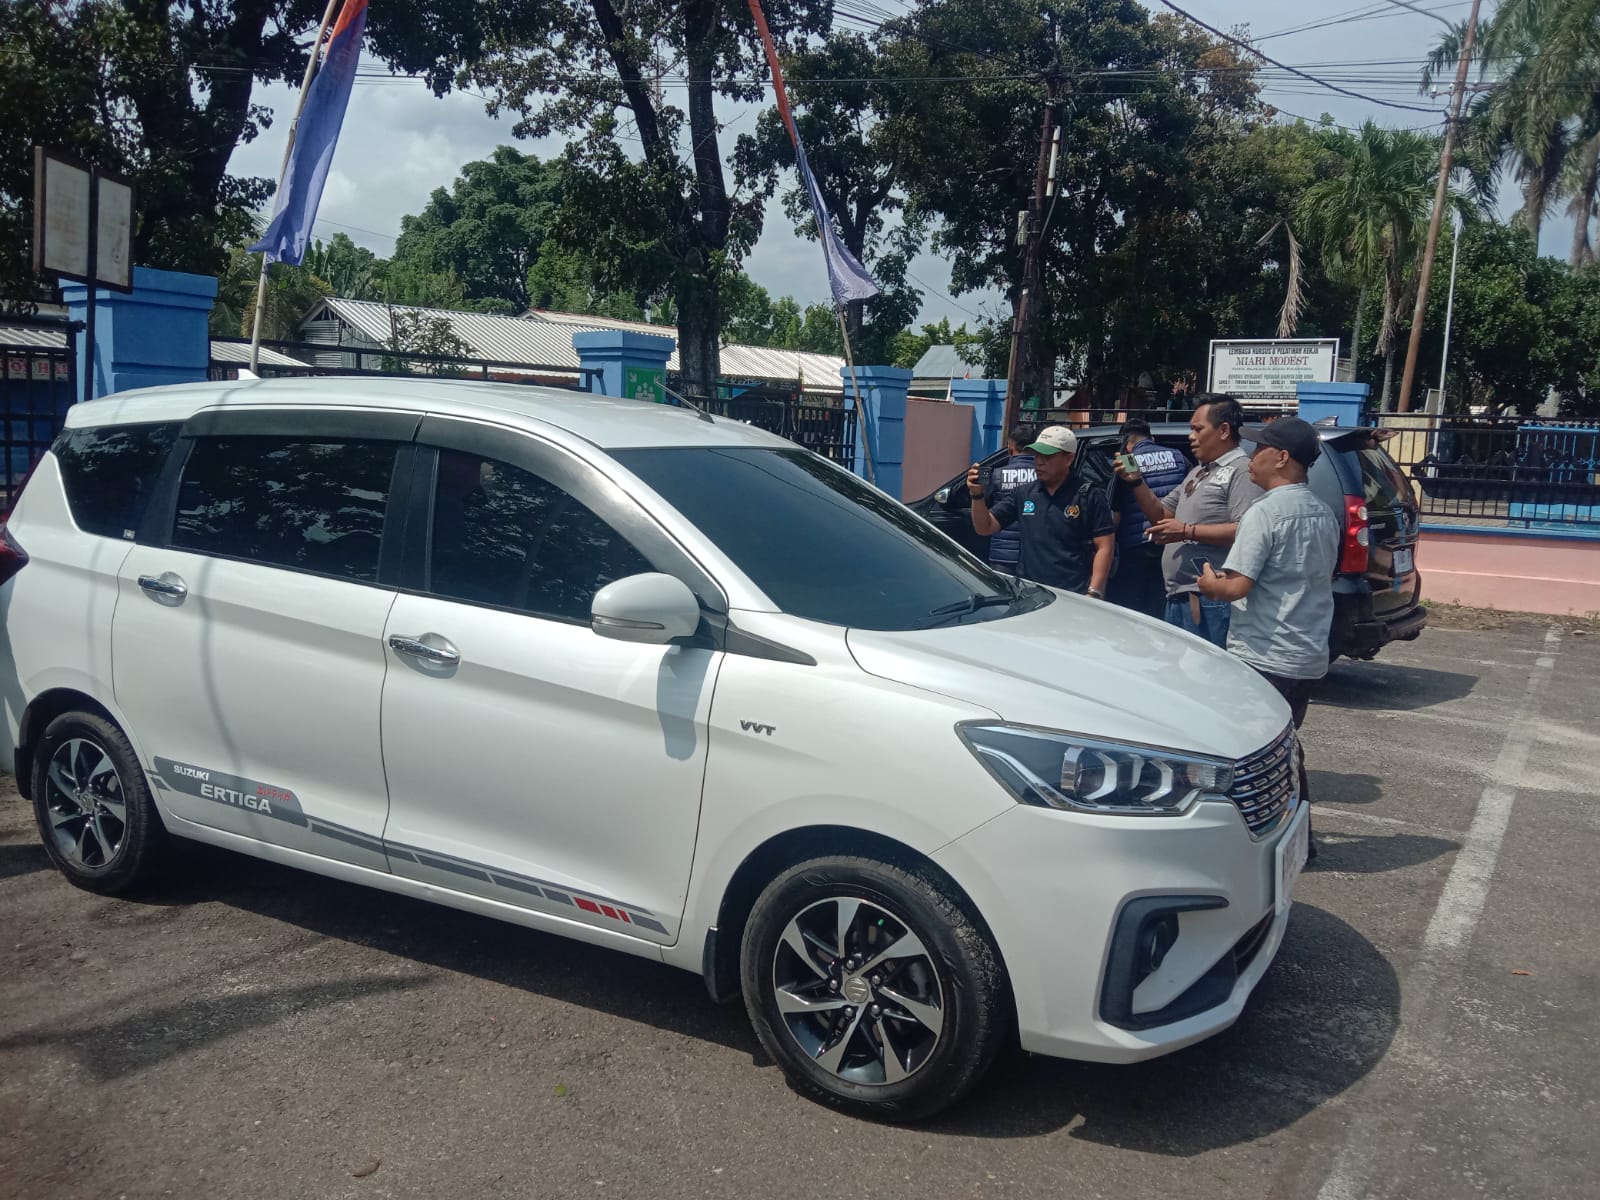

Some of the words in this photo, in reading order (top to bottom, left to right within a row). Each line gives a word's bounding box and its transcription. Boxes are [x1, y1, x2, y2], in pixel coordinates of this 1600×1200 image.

[1236, 356, 1265, 365] MIARI
[1270, 356, 1309, 365] MODEST
[740, 719, 777, 737] VVT
[173, 764, 210, 781] SUZUKI
[200, 783, 272, 814] ERTIGA
